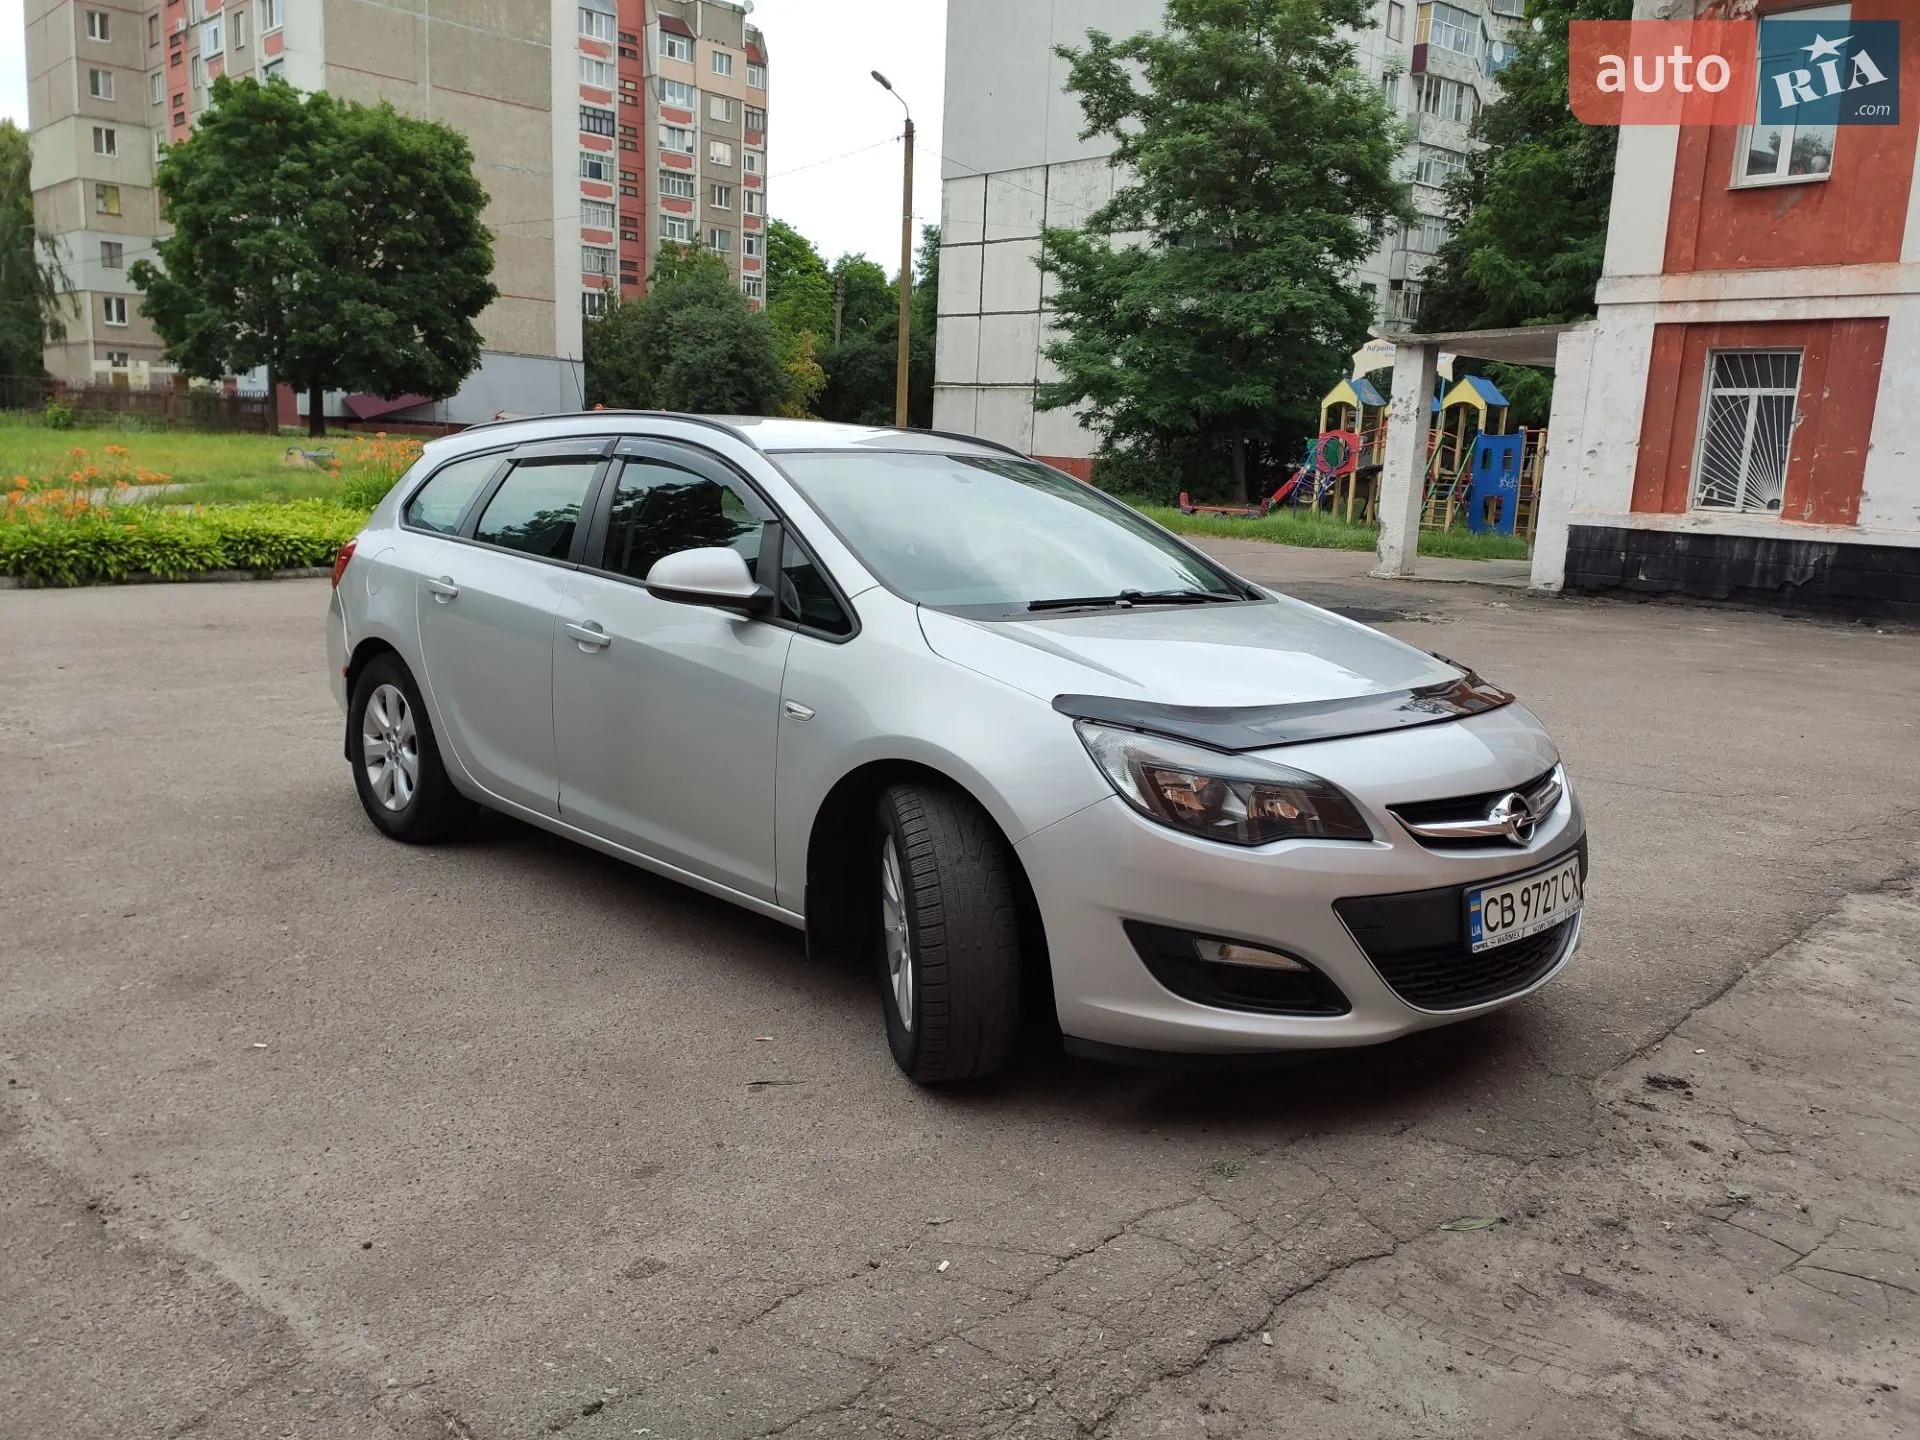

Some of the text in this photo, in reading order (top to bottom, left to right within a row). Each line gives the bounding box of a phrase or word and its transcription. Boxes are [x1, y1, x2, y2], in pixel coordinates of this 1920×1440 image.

[1484, 864, 1580, 932] CB 9727 CX
[1471, 924, 1482, 937] UA
